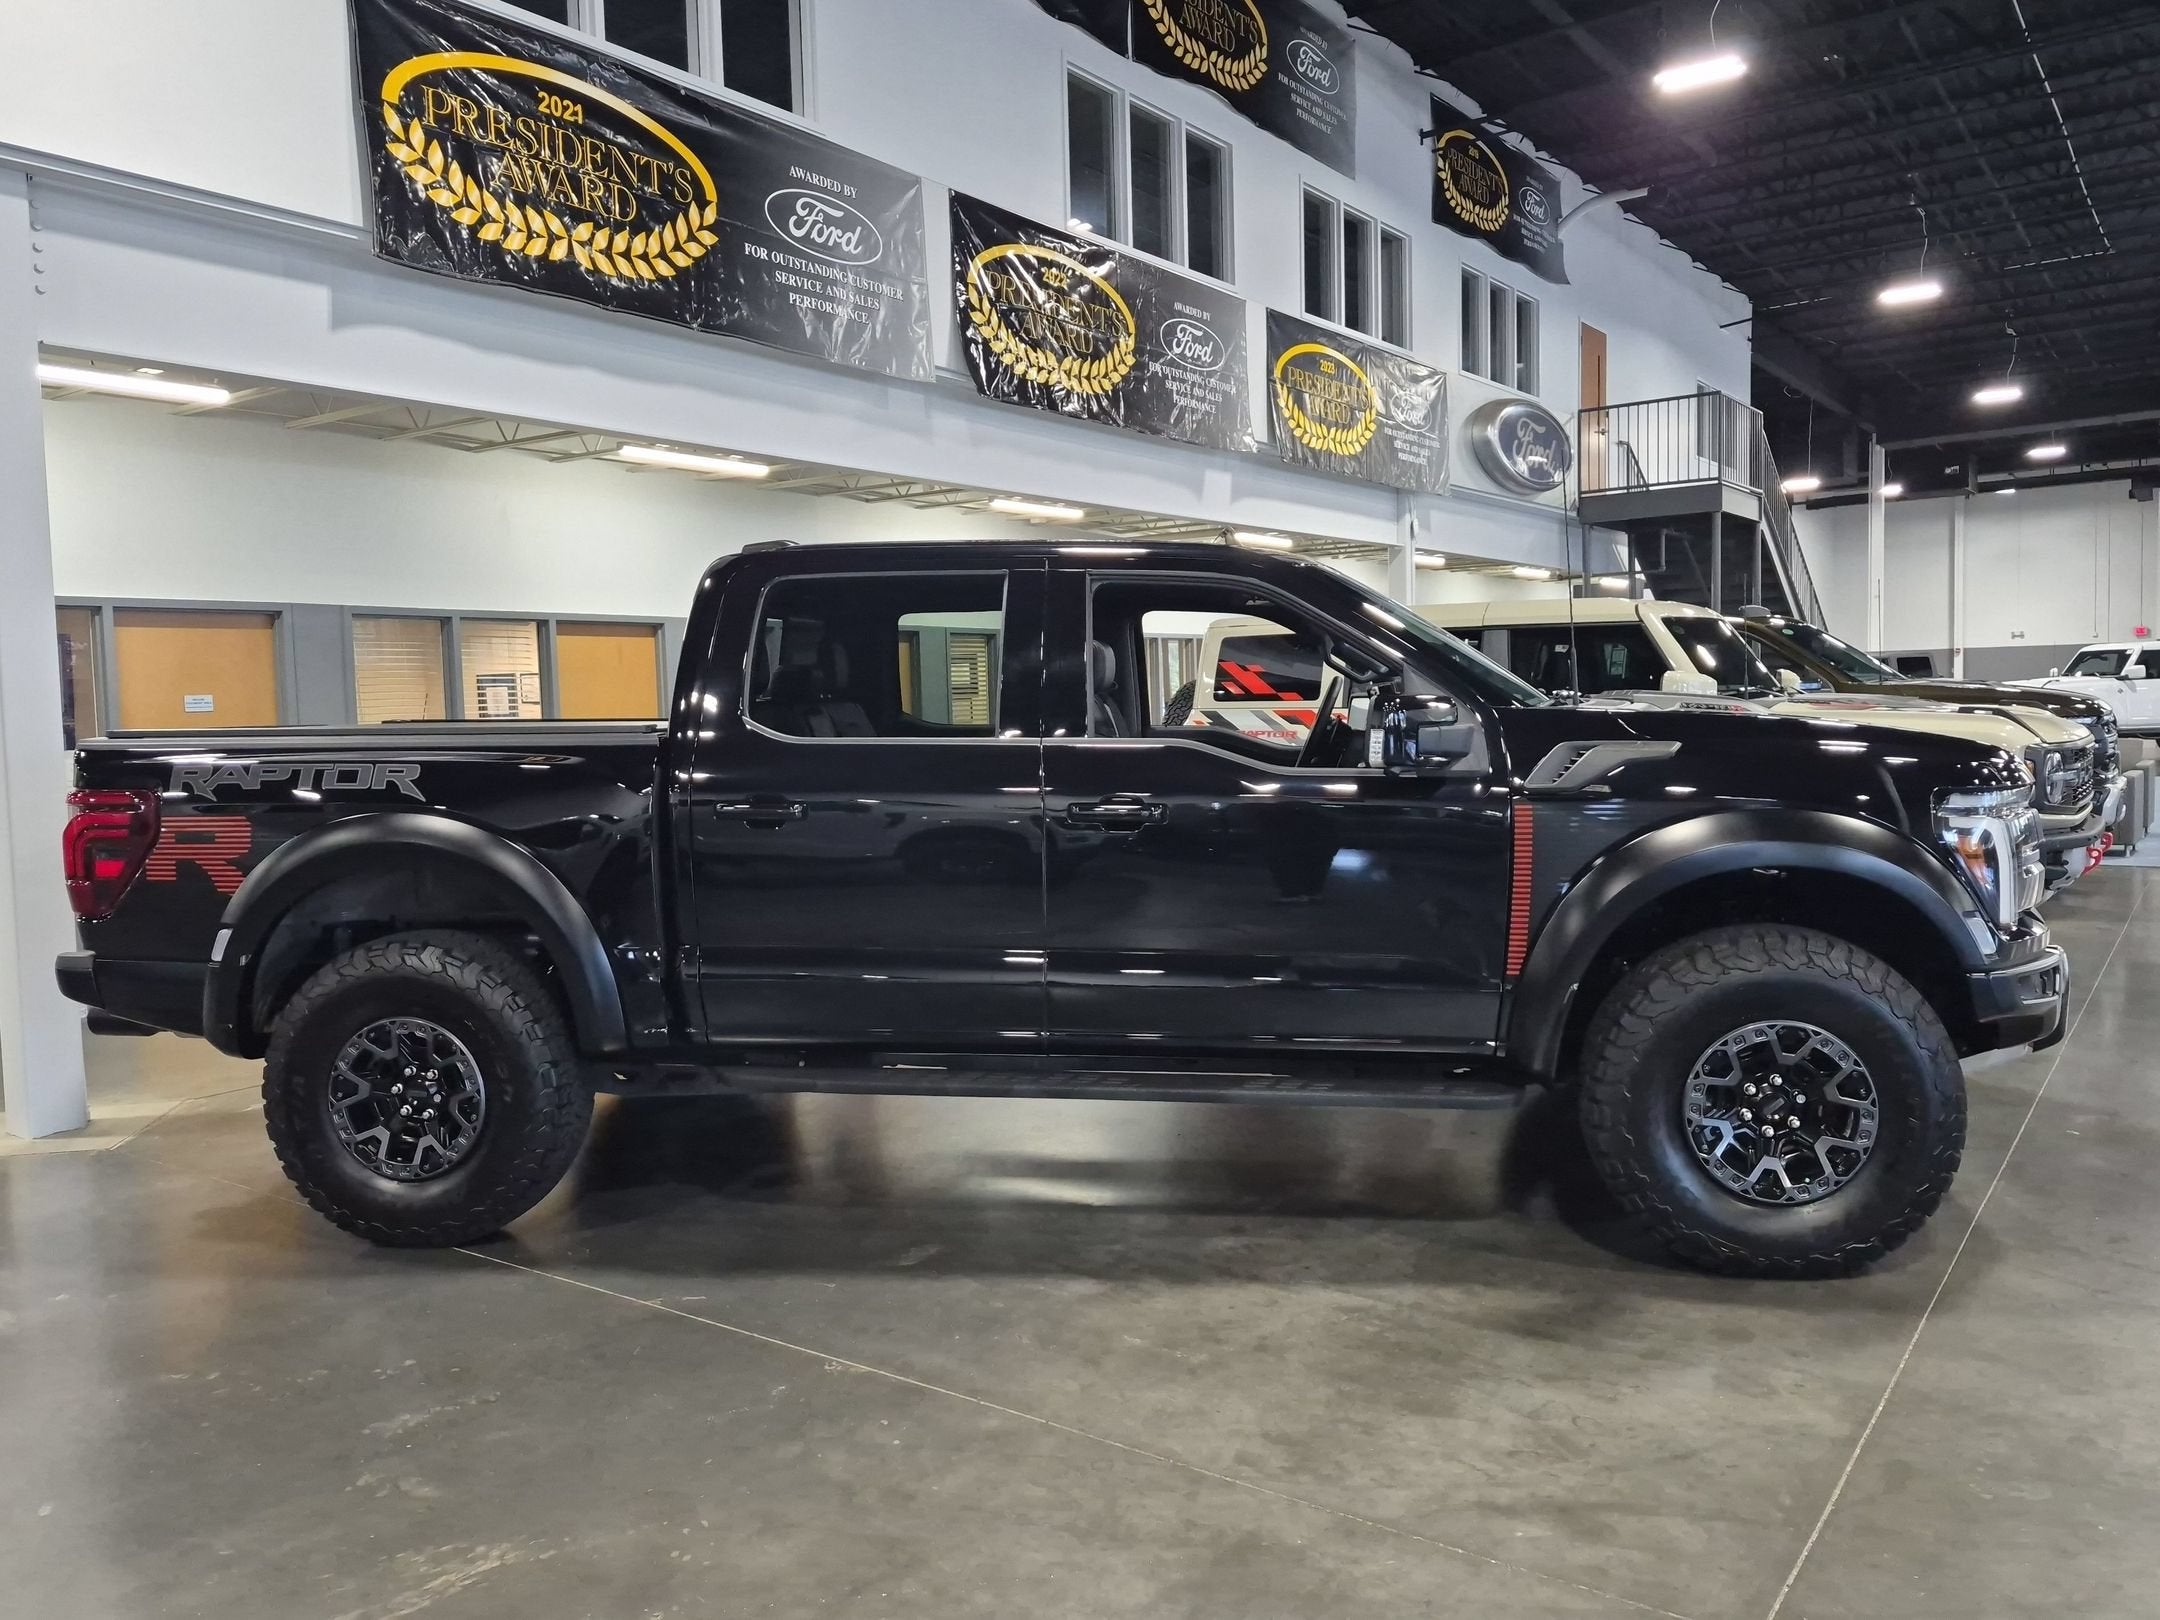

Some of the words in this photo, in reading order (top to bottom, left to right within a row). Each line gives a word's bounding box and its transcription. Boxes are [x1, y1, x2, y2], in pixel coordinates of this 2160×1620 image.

[1178, 3, 1236, 53] AWARD
[1297, 46, 1332, 88] Ford
[1278, 72, 1289, 86] FOR
[1289, 79, 1324, 106] OUTSTANDING
[537, 91, 584, 124] 2021
[1291, 93, 1312, 111] SERVICE
[1312, 106, 1323, 117] AND
[1322, 111, 1338, 125] SALES
[1297, 107, 1332, 135] PERFORMANCE
[420, 84, 693, 203] PRESIDENT'S
[490, 151, 637, 222] AWARD
[789, 165, 842, 194] AWARDED
[844, 183, 858, 199] BY
[1457, 173, 1490, 205] AWARD
[1525, 191, 1545, 220] Ford
[789, 197, 863, 254] Ford
[744, 242, 769, 261] FOR
[771, 250, 848, 285] OUTSTANDING
[850, 274, 904, 301] CUSTOMER
[775, 270, 823, 294] SERVICE
[825, 285, 847, 300] AND
[849, 291, 880, 310] SALES
[985, 270, 1125, 337] PREDENT'S
[789, 292, 870, 324] PERFORMANCE
[1173, 302, 1202, 319] AWARDED
[1203, 311, 1211, 321] BY
[1173, 324, 1213, 362] Ford
[1149, 361, 1161, 373] FOR
[1164, 366, 1205, 386] OUTSTANDING
[1206, 377, 1237, 394] CUSTOMER
[1165, 379, 1191, 393] SERVICE
[1193, 388, 1205, 399] AND
[1205, 390, 1223, 402] SALES
[1286, 365, 1369, 410] PRESIDENT'S
[1173, 395, 1217, 414] PERFORMANCE
[1397, 396, 1426, 426] Ford
[1513, 417, 1556, 472] Ford
[169, 763, 427, 802] RAPTOR
